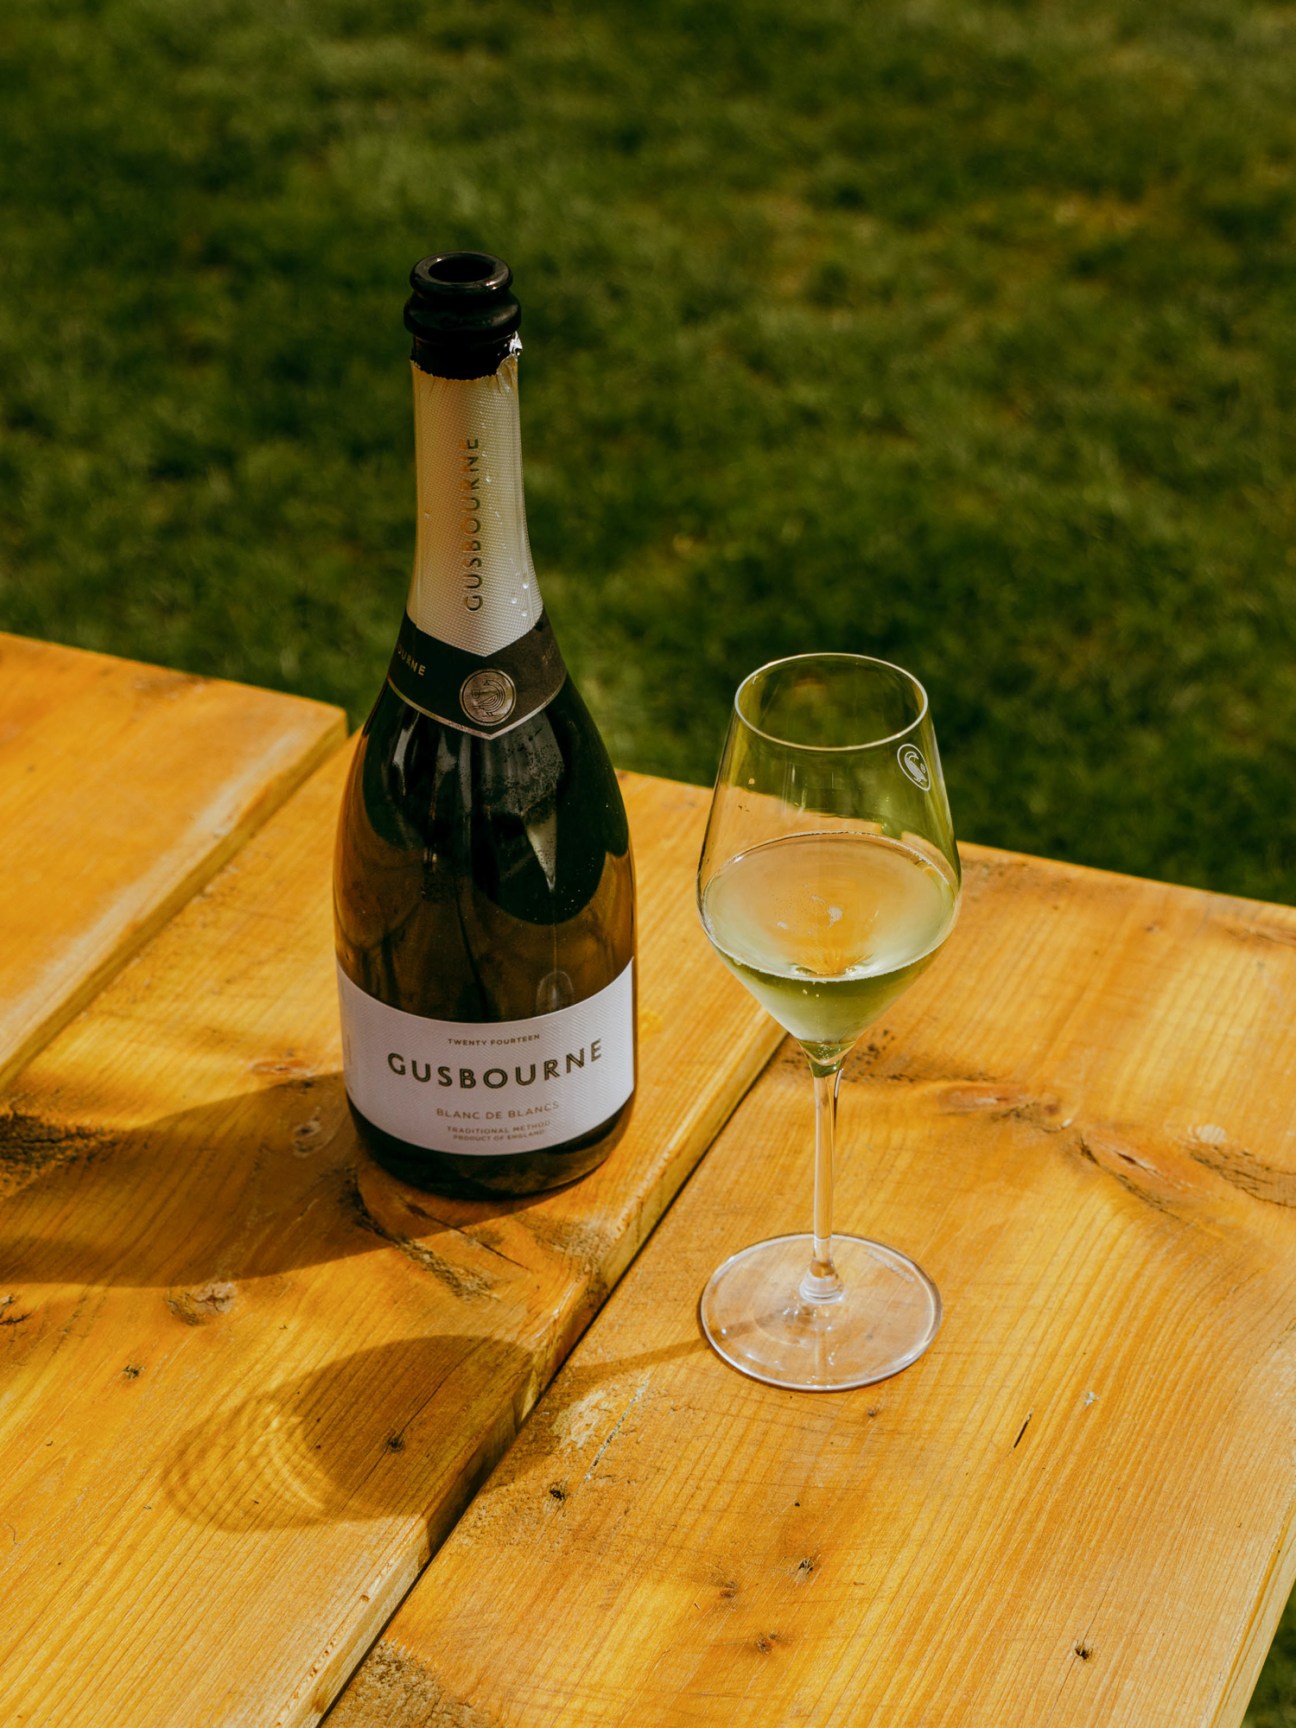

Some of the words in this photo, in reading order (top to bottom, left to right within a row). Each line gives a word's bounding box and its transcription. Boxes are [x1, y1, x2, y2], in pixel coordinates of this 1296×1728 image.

[462, 438, 483, 611] GUSBOURNE
[447, 1038, 487, 1047] TWENTY
[490, 1034, 540, 1046] FOURTEEN
[388, 1039, 602, 1089] GUSBOURNE
[435, 1107, 484, 1121] BLANC
[485, 1110, 503, 1120] DE
[508, 1101, 560, 1118] BLANCS
[446, 1125, 510, 1135] TRADITIONAL
[512, 1120, 550, 1132] METHOD
[452, 1133, 492, 1142] PRODUCT
[493, 1134, 505, 1142] OF
[507, 1130, 545, 1140] ENGLAND
